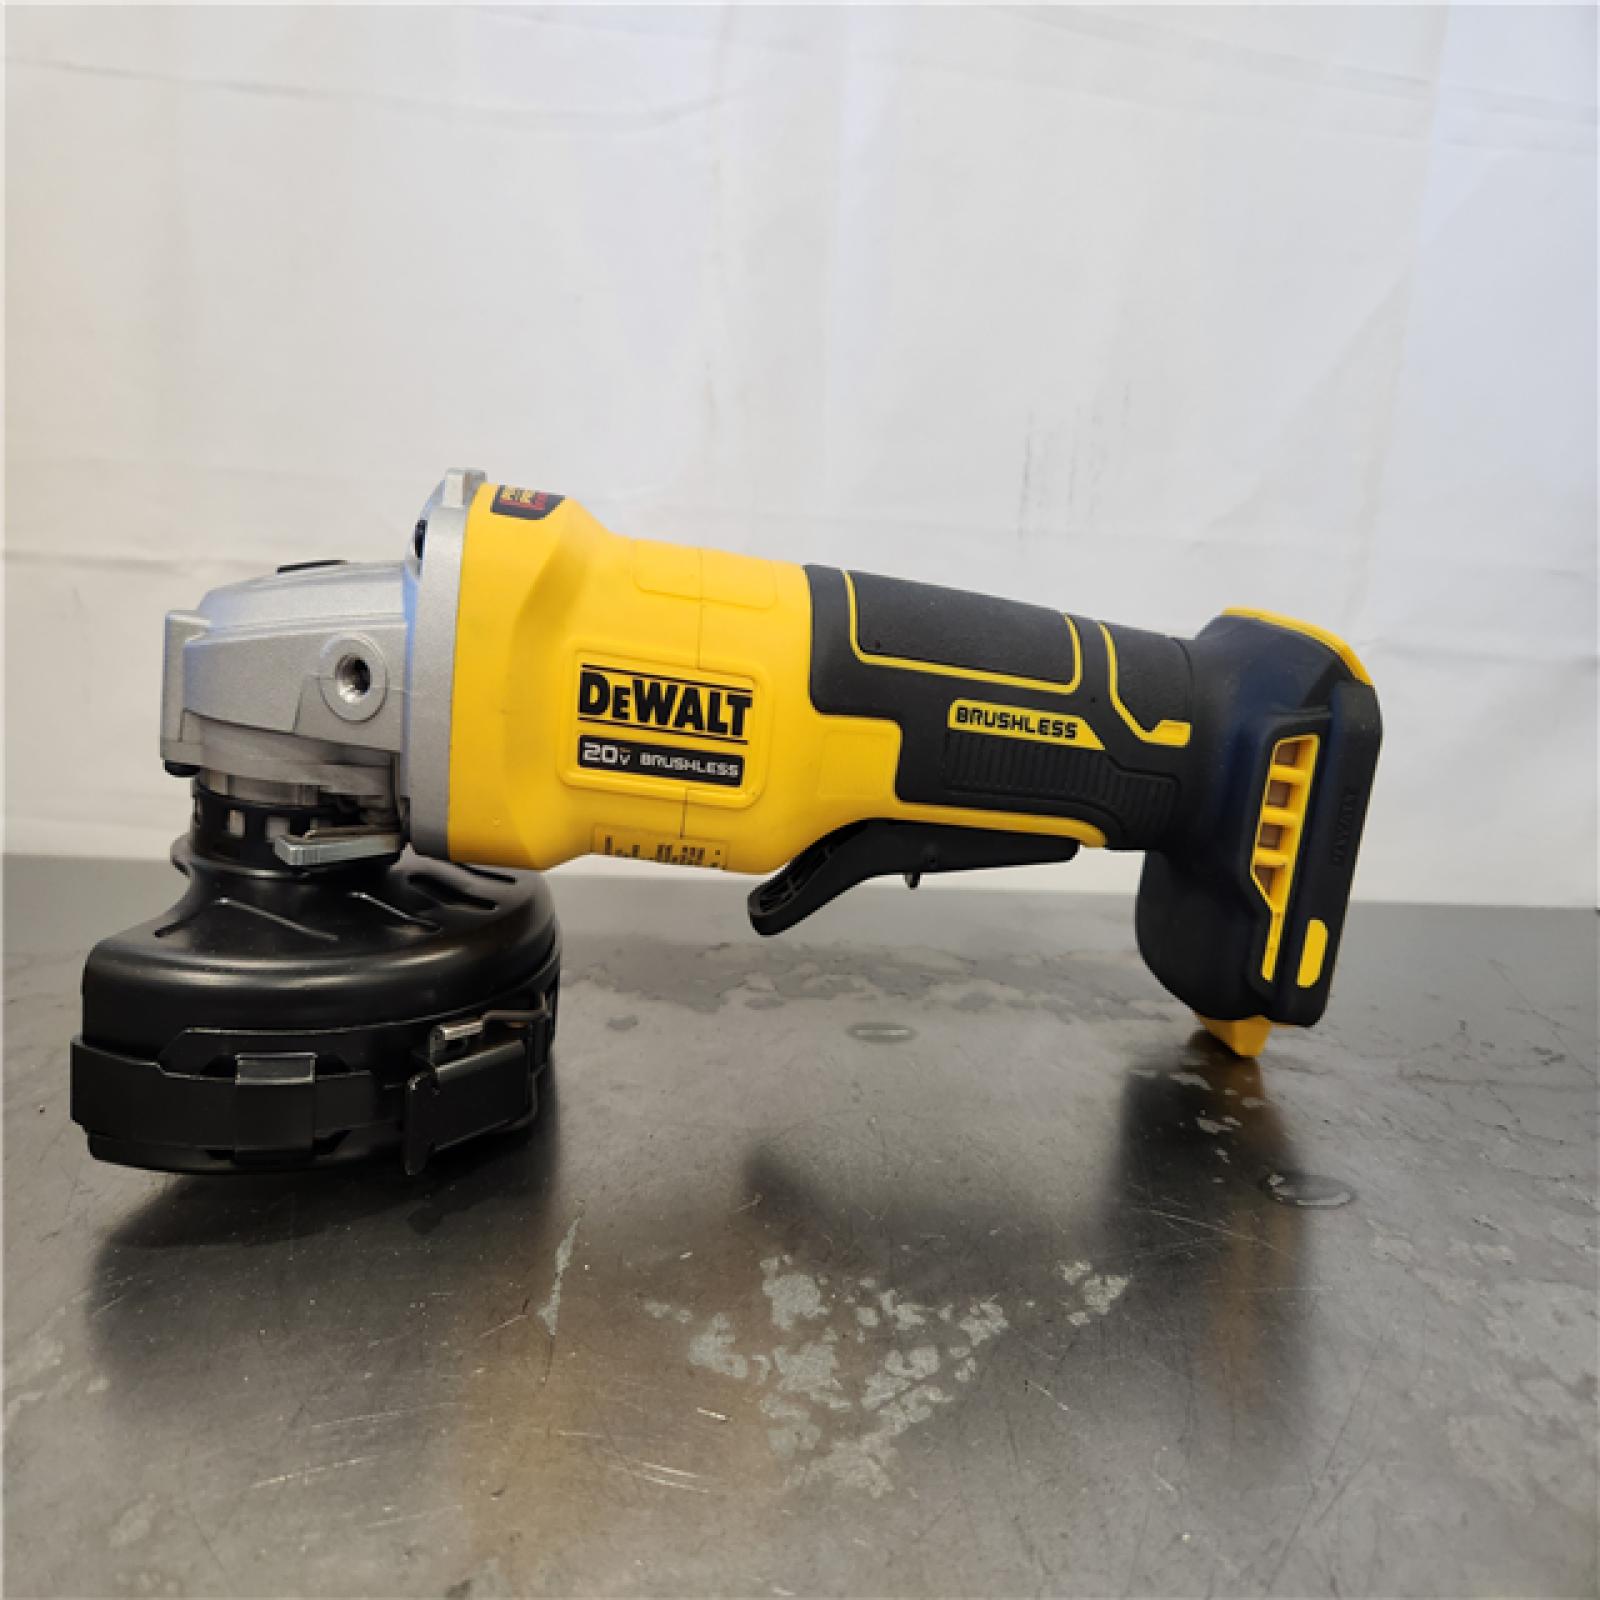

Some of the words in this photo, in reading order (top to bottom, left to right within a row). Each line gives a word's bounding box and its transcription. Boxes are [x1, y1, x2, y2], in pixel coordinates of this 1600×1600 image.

[579, 671, 752, 736] DEWALT
[956, 705, 1078, 740] BRUSHLESS
[639, 752, 739, 777] BRUSHLESS
